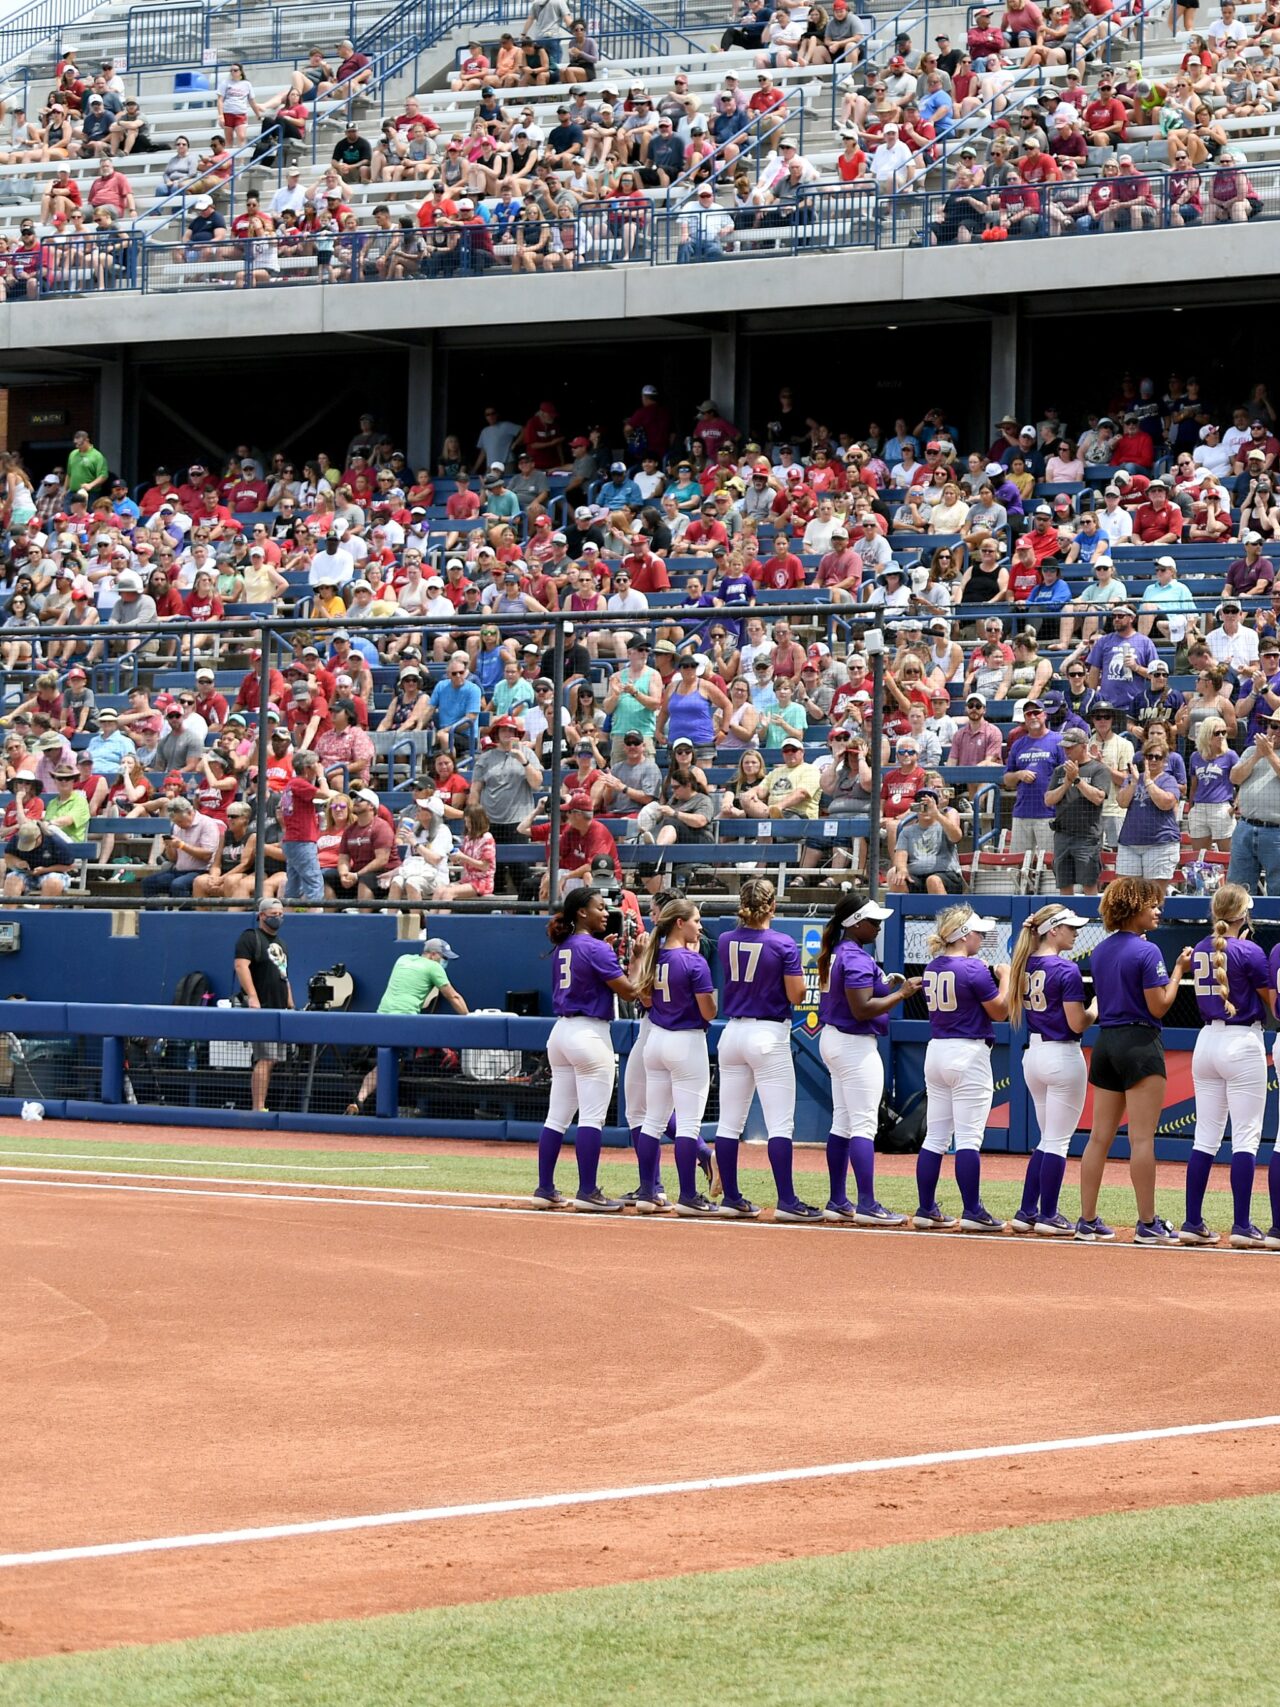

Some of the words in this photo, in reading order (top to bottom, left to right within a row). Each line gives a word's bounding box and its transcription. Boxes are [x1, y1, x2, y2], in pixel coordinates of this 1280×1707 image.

[559, 949, 571, 989] 3
[729, 941, 763, 982] 17
[924, 971, 957, 1012] 30
